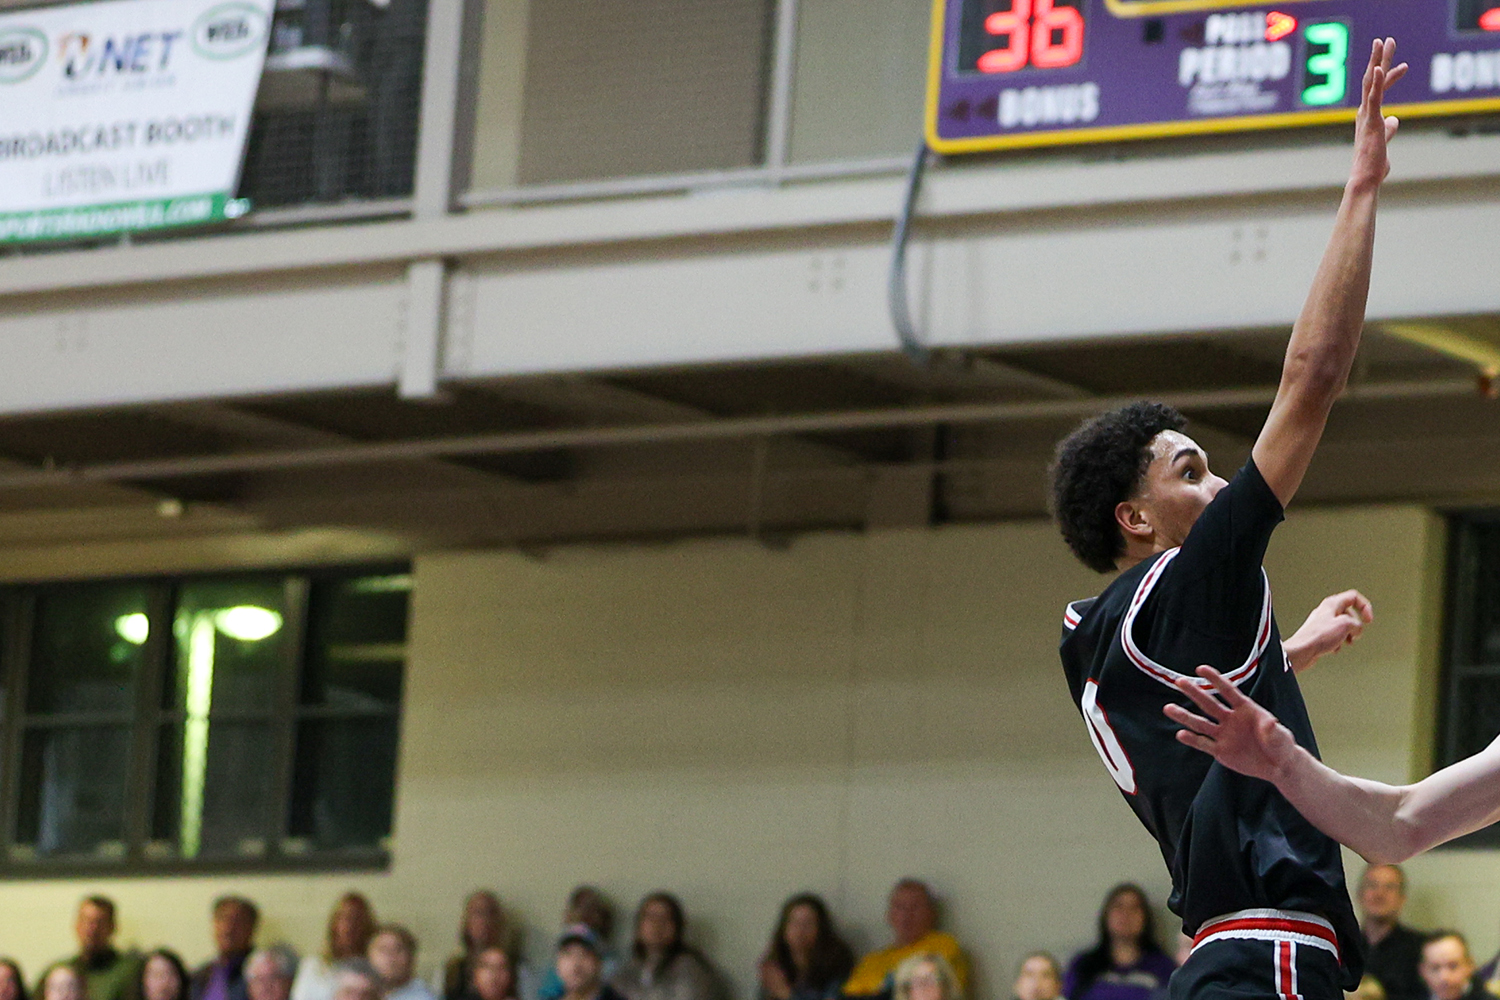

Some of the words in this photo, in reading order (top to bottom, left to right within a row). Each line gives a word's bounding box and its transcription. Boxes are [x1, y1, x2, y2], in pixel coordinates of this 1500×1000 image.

[976, 0, 1086, 73] 36
[1178, 42, 1291, 87] PERIOD
[1301, 22, 1349, 105] 3
[998, 82, 1100, 128] BONUS
[146, 115, 235, 144] BOOTH
